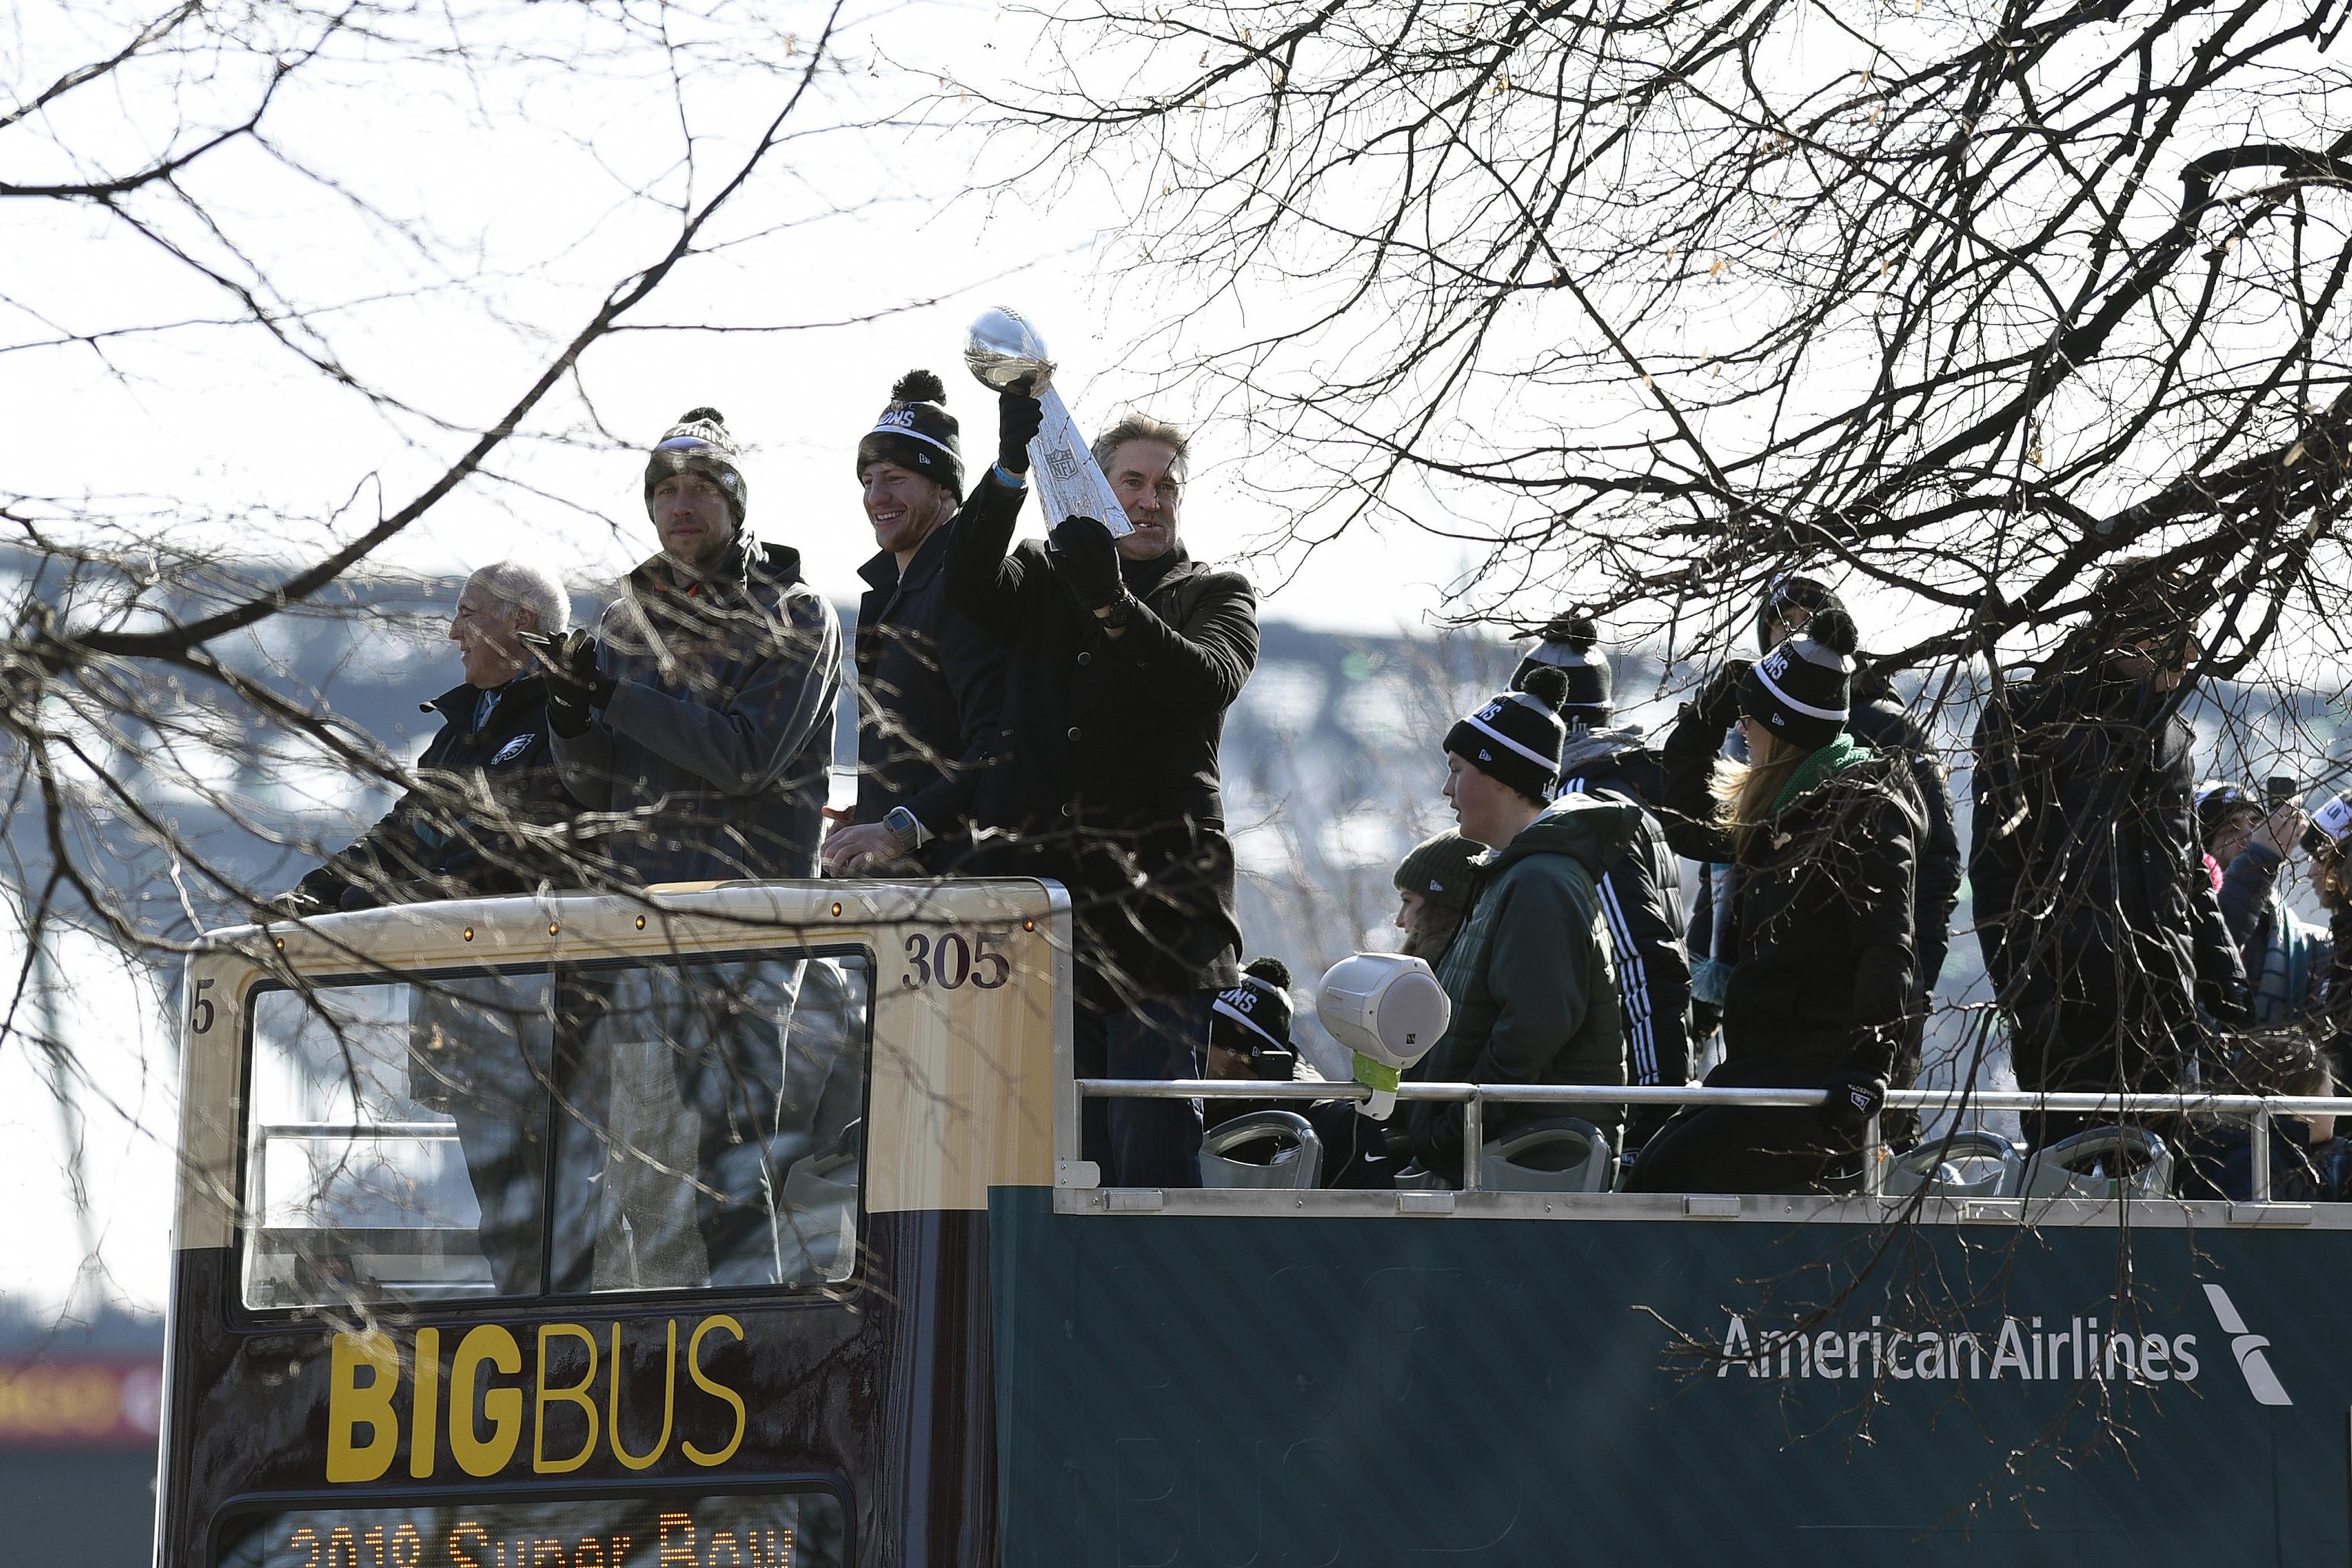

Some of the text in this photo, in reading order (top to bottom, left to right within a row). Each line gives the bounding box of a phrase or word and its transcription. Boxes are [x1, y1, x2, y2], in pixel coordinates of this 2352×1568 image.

[1050, 459, 1076, 477] NFL
[902, 932, 1011, 991] 305
[1717, 1315, 2200, 1382] American Airlines
